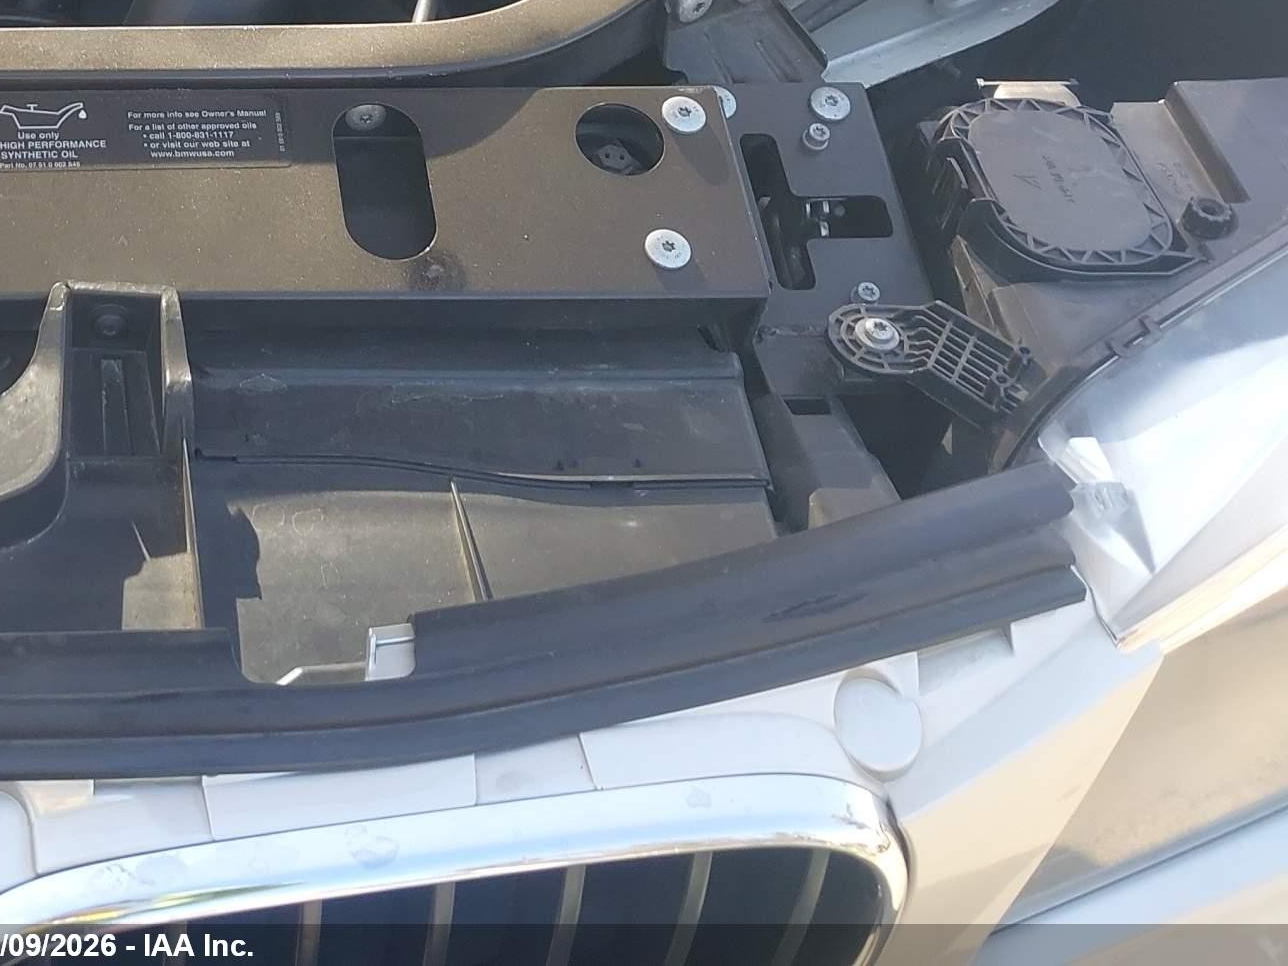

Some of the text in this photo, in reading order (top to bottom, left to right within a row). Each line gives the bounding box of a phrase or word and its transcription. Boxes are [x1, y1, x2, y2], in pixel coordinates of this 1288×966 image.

[236, 109, 267, 117] Manual
[201, 122, 240, 131] approved
[17, 131, 59, 140] Use only
[168, 131, 234, 139] 1-800-831-1117
[0, 141, 25, 149] HIGH
[28, 139, 106, 149] PERFORMANCE
[1, 150, 78, 159] SYNTHETIC OIL
[151, 150, 234, 158] www.bmwusa.com
